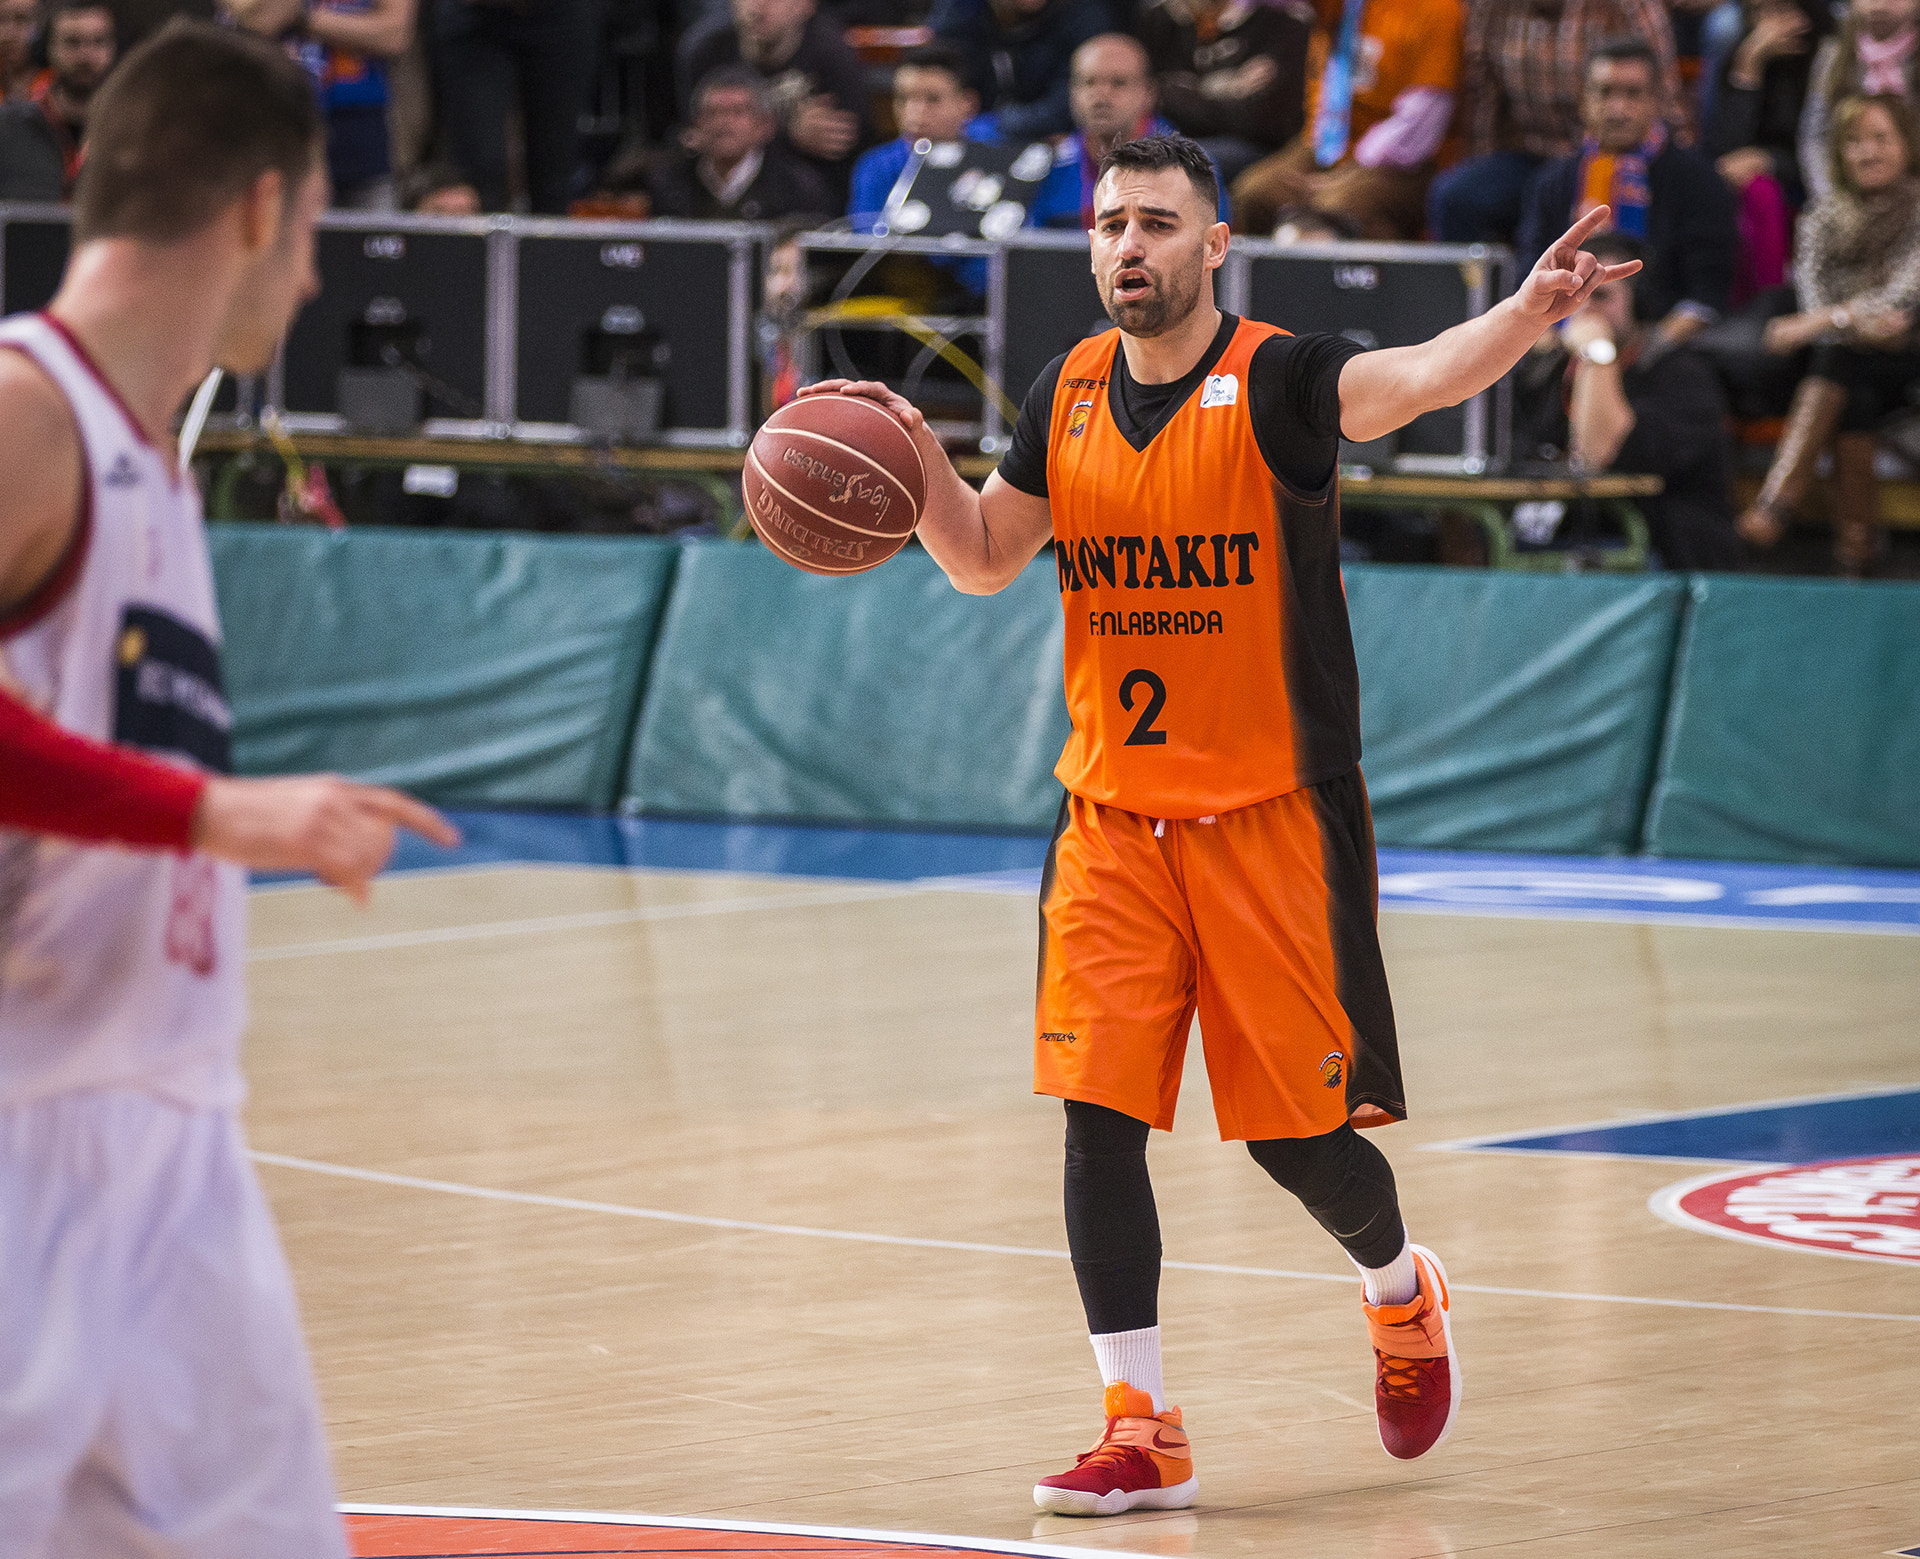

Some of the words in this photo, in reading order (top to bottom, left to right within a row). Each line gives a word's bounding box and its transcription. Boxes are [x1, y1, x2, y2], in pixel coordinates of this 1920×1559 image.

[756, 489, 872, 562] SPALDING
[1055, 531, 1260, 594] MONTAKIT
[1118, 668, 1167, 747] 2
